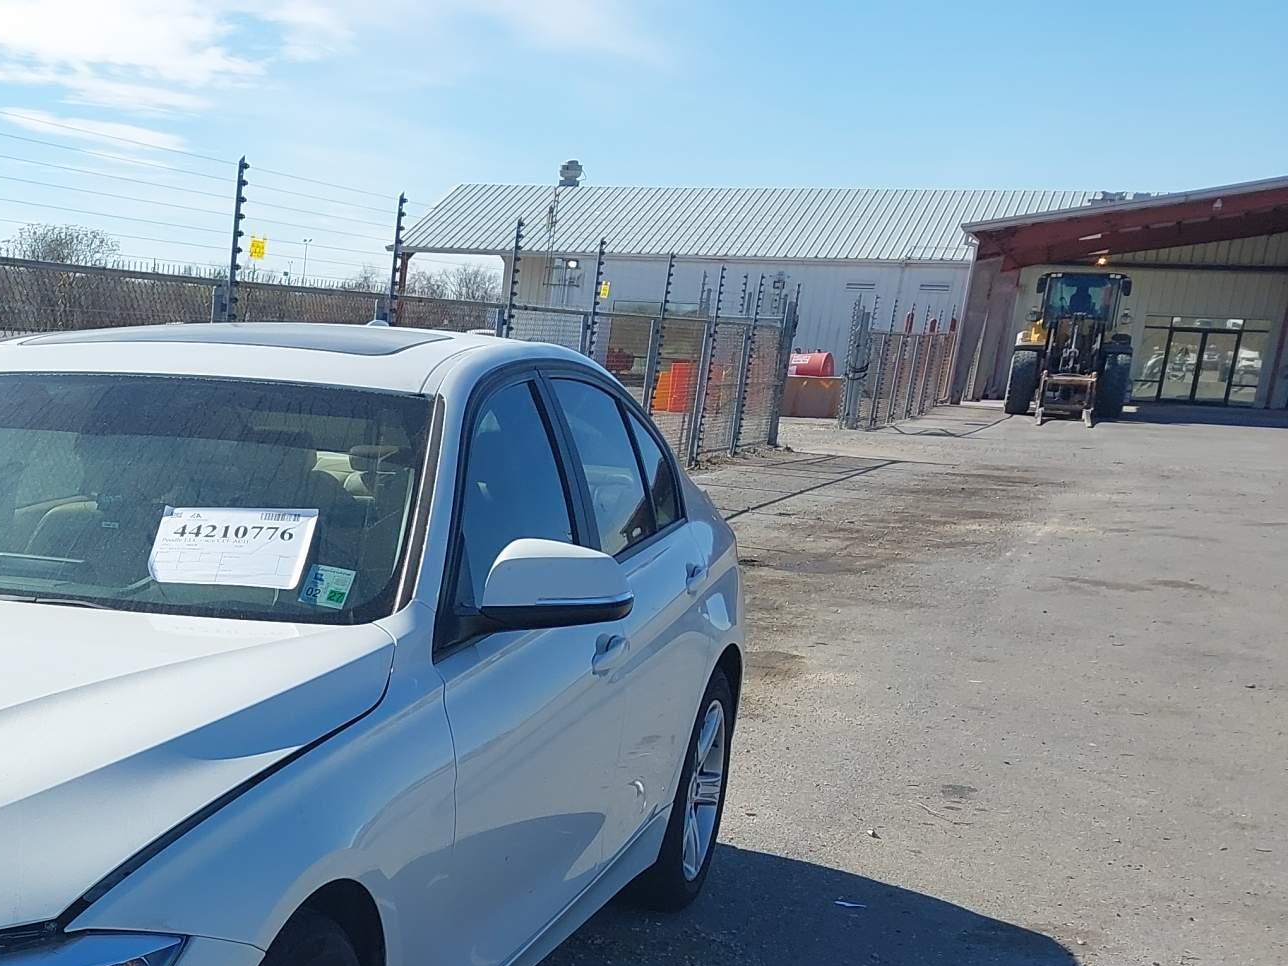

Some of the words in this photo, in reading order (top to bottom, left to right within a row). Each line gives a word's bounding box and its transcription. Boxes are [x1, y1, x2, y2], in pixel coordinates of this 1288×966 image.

[173, 524, 295, 541] 44210776
[305, 586, 321, 598] 02
[327, 590, 345, 603] 27
